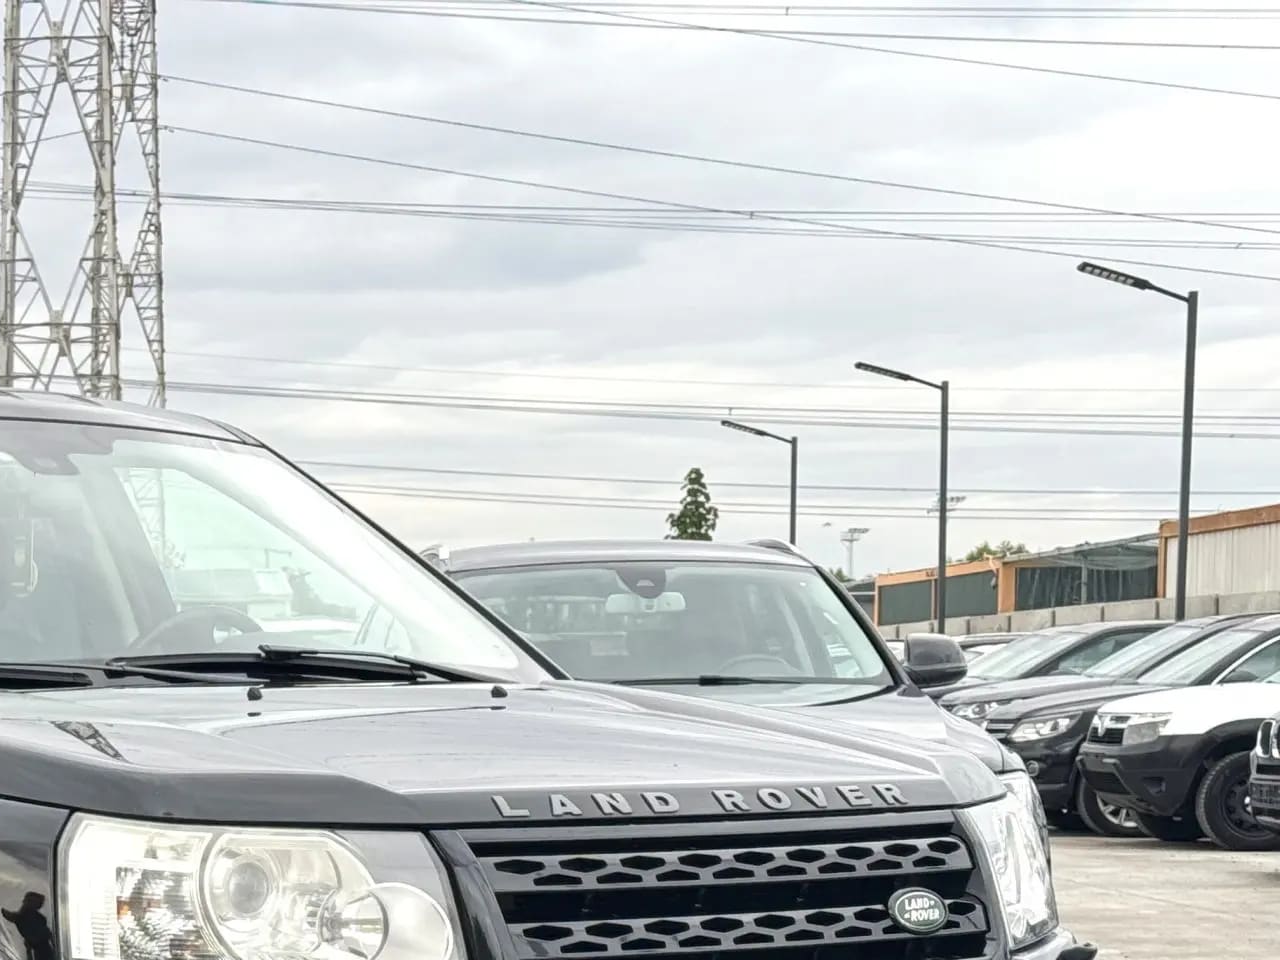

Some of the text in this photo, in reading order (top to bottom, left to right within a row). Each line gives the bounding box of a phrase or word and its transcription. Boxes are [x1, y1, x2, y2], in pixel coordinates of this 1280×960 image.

[491, 783, 909, 818] LAND ROVER
[904, 897, 930, 911] LAND
[910, 908, 940, 922] ROVER
